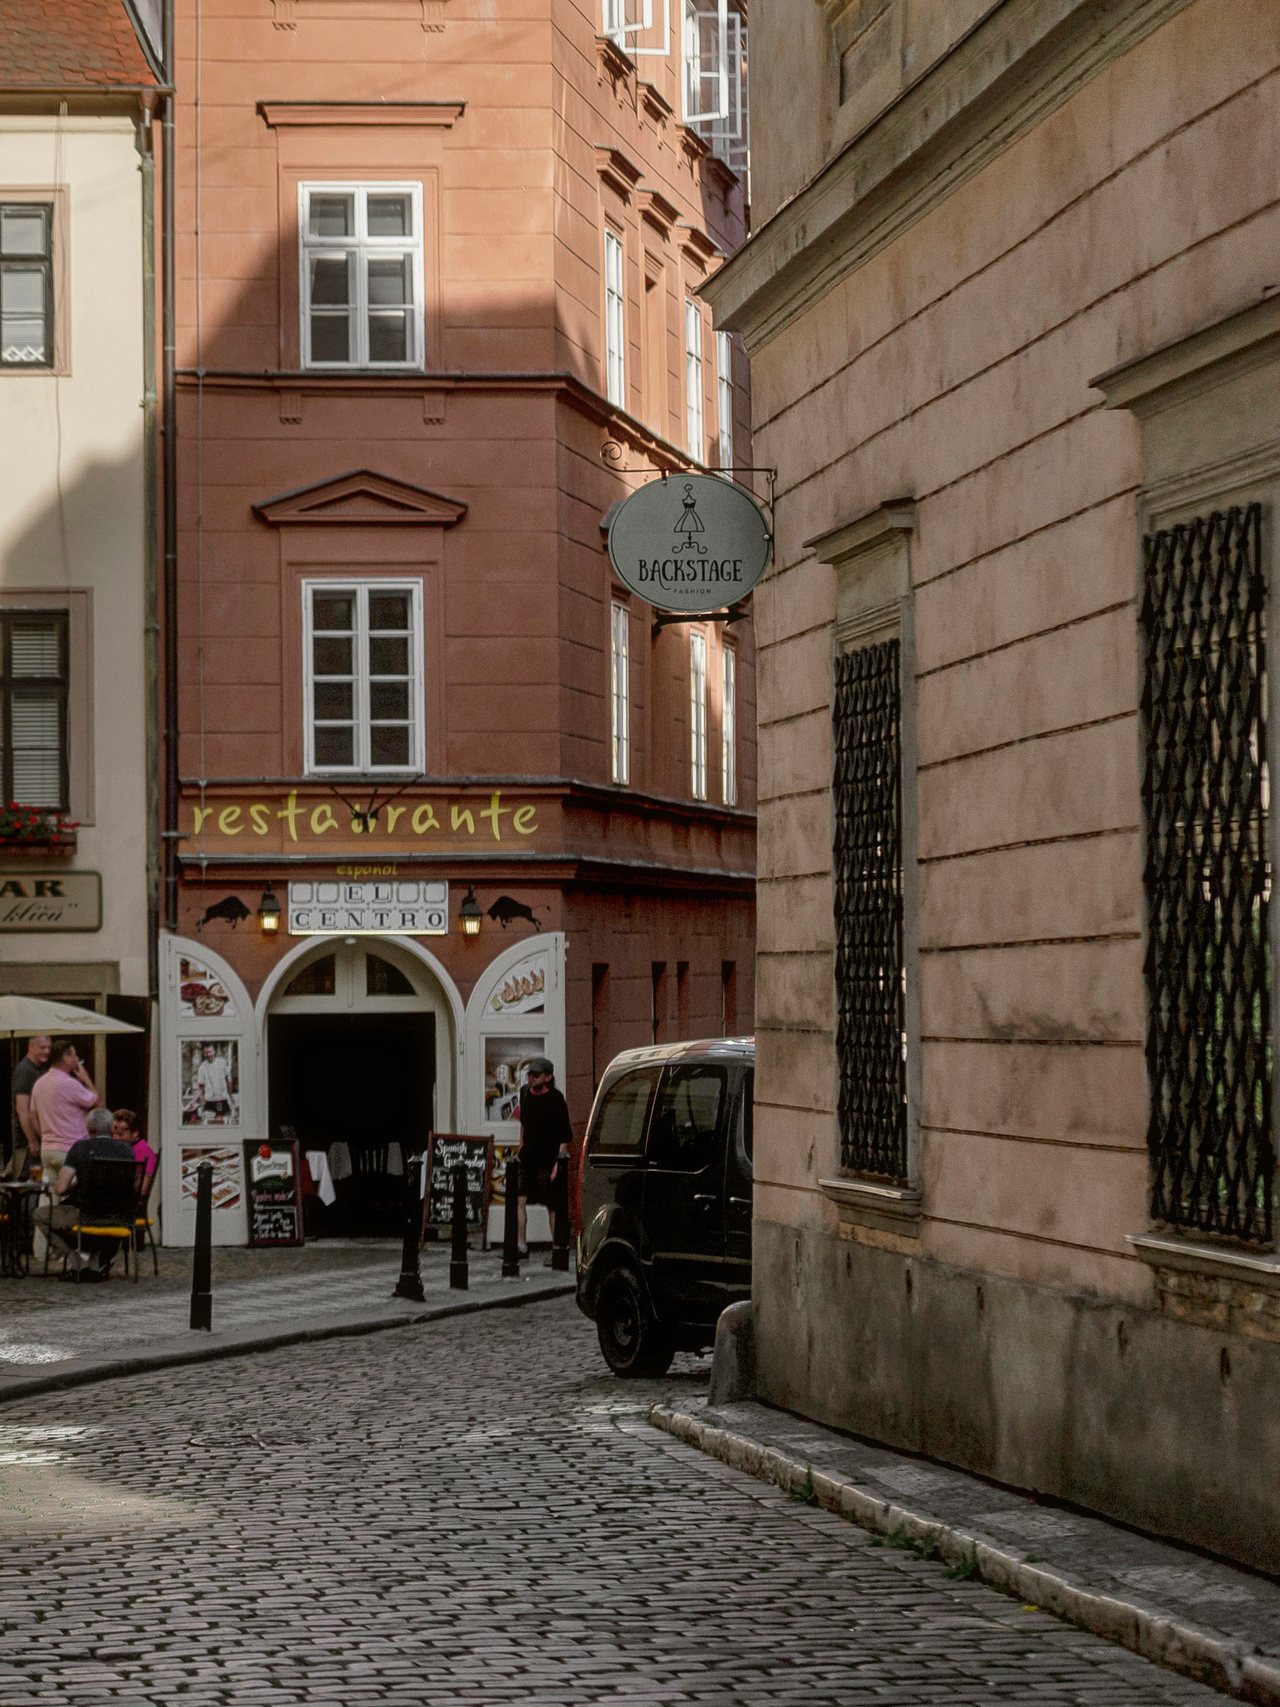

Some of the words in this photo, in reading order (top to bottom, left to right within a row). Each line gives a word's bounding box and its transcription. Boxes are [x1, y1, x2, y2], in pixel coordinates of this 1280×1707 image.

[638, 559, 743, 590] BACKSTAGE
[193, 790, 539, 842] restaurante
[348, 886, 390, 901] EL
[294, 912, 443, 927] CENTRO
